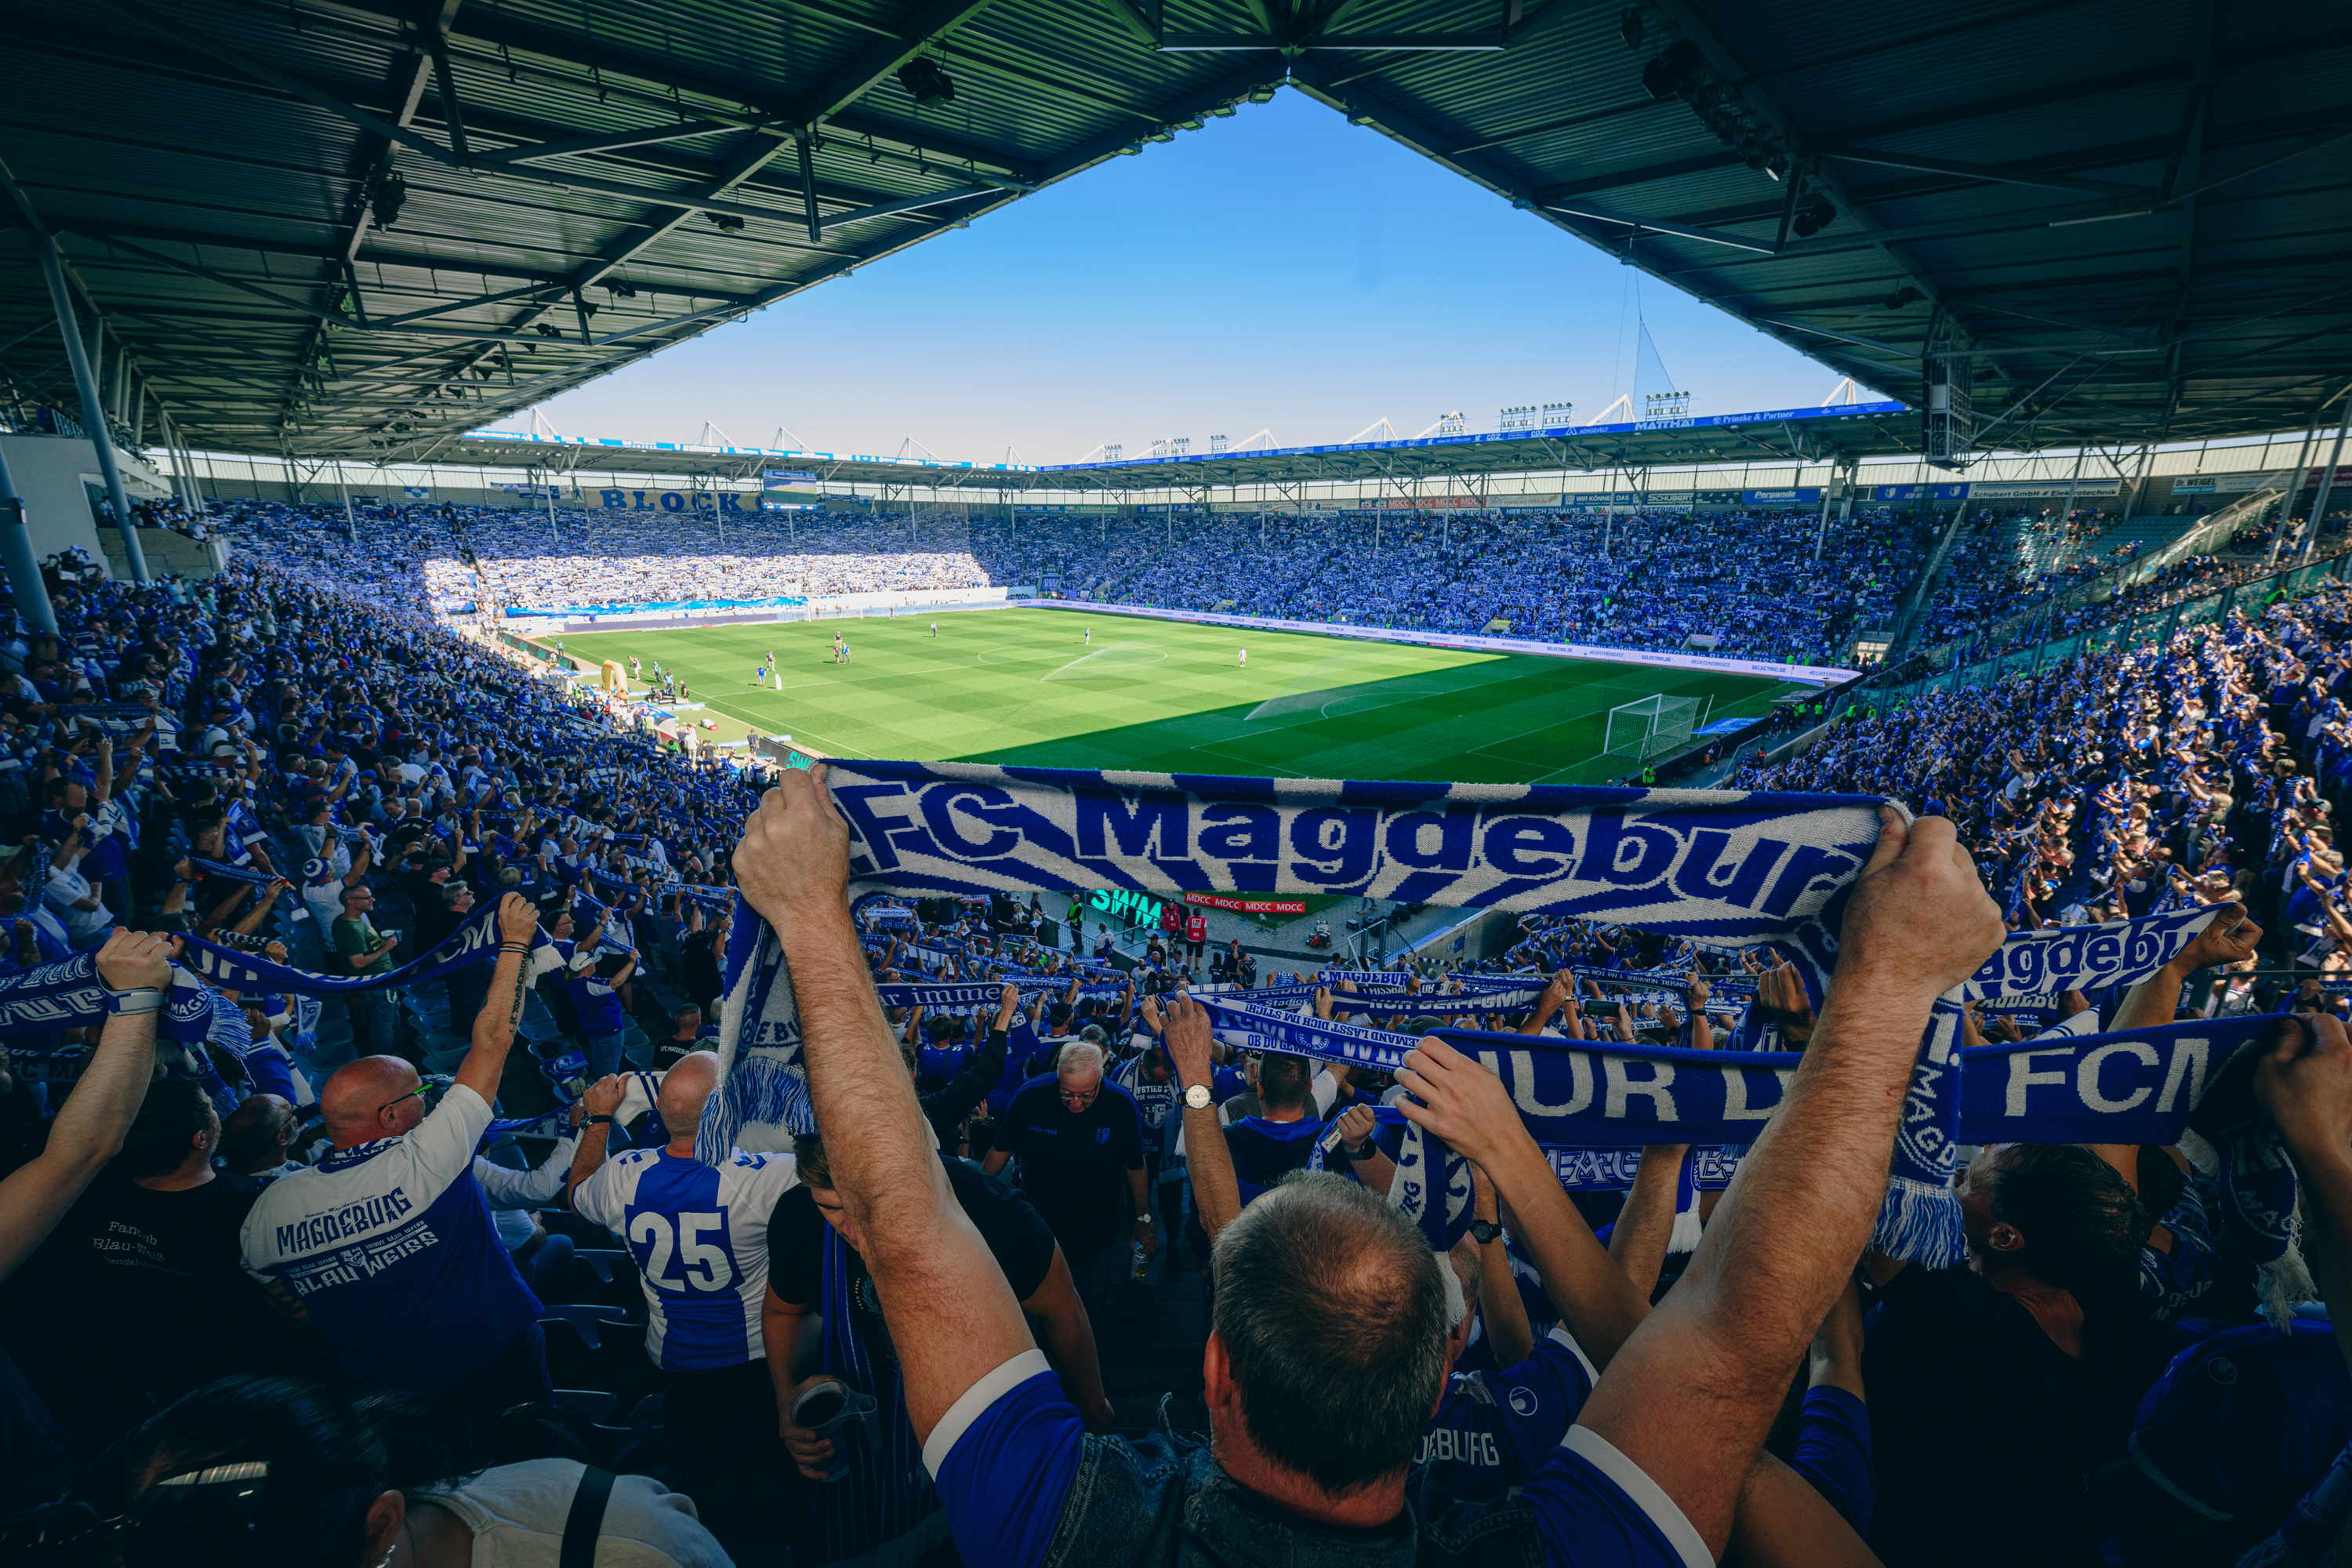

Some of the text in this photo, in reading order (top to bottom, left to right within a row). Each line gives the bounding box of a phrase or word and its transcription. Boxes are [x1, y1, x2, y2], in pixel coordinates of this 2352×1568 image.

[1722, 413, 1751, 423] Prinzke
[1763, 410, 1795, 419] Partner
[2187, 477, 2216, 486] WEIGEL
[600, 488, 742, 510] BLOCK
[1755, 490, 1796, 499] Pergande
[2051, 488, 2118, 497] Elekrotechnik
[1643, 505, 1691, 514] STTRIBÜNE
[1589, 649, 1624, 658] #ECHTEREINSATZ
[1690, 659, 1731, 668] #ECHTEREINSATZ
[1751, 664, 1787, 673] SELECTRIC.DE
[840, 781, 1021, 870] FC
[1186, 894, 1240, 909] MDCC MDCC
[1245, 902, 1303, 912] MDCC MDCC
[1091, 889, 1162, 930] SWM
[1627, 974, 1658, 985] NUMMER
[1661, 978, 1687, 989] UNSERE
[1244, 1002, 1283, 1020] STICH!
[1283, 1011, 1298, 1024] IM
[1302, 1016, 1330, 1032] DICH
[1330, 1022, 1363, 1040] LÄSST
[1247, 1033, 1261, 1047] OB
[1263, 1035, 1277, 1048] DU
[1044, 1127, 1058, 1136] 1965
[275, 1186, 414, 1258] MAGDEBURG
[107, 1221, 158, 1246] Fancub
[630, 1210, 734, 1294] 25
[292, 1231, 440, 1297] BLAU WEISS
